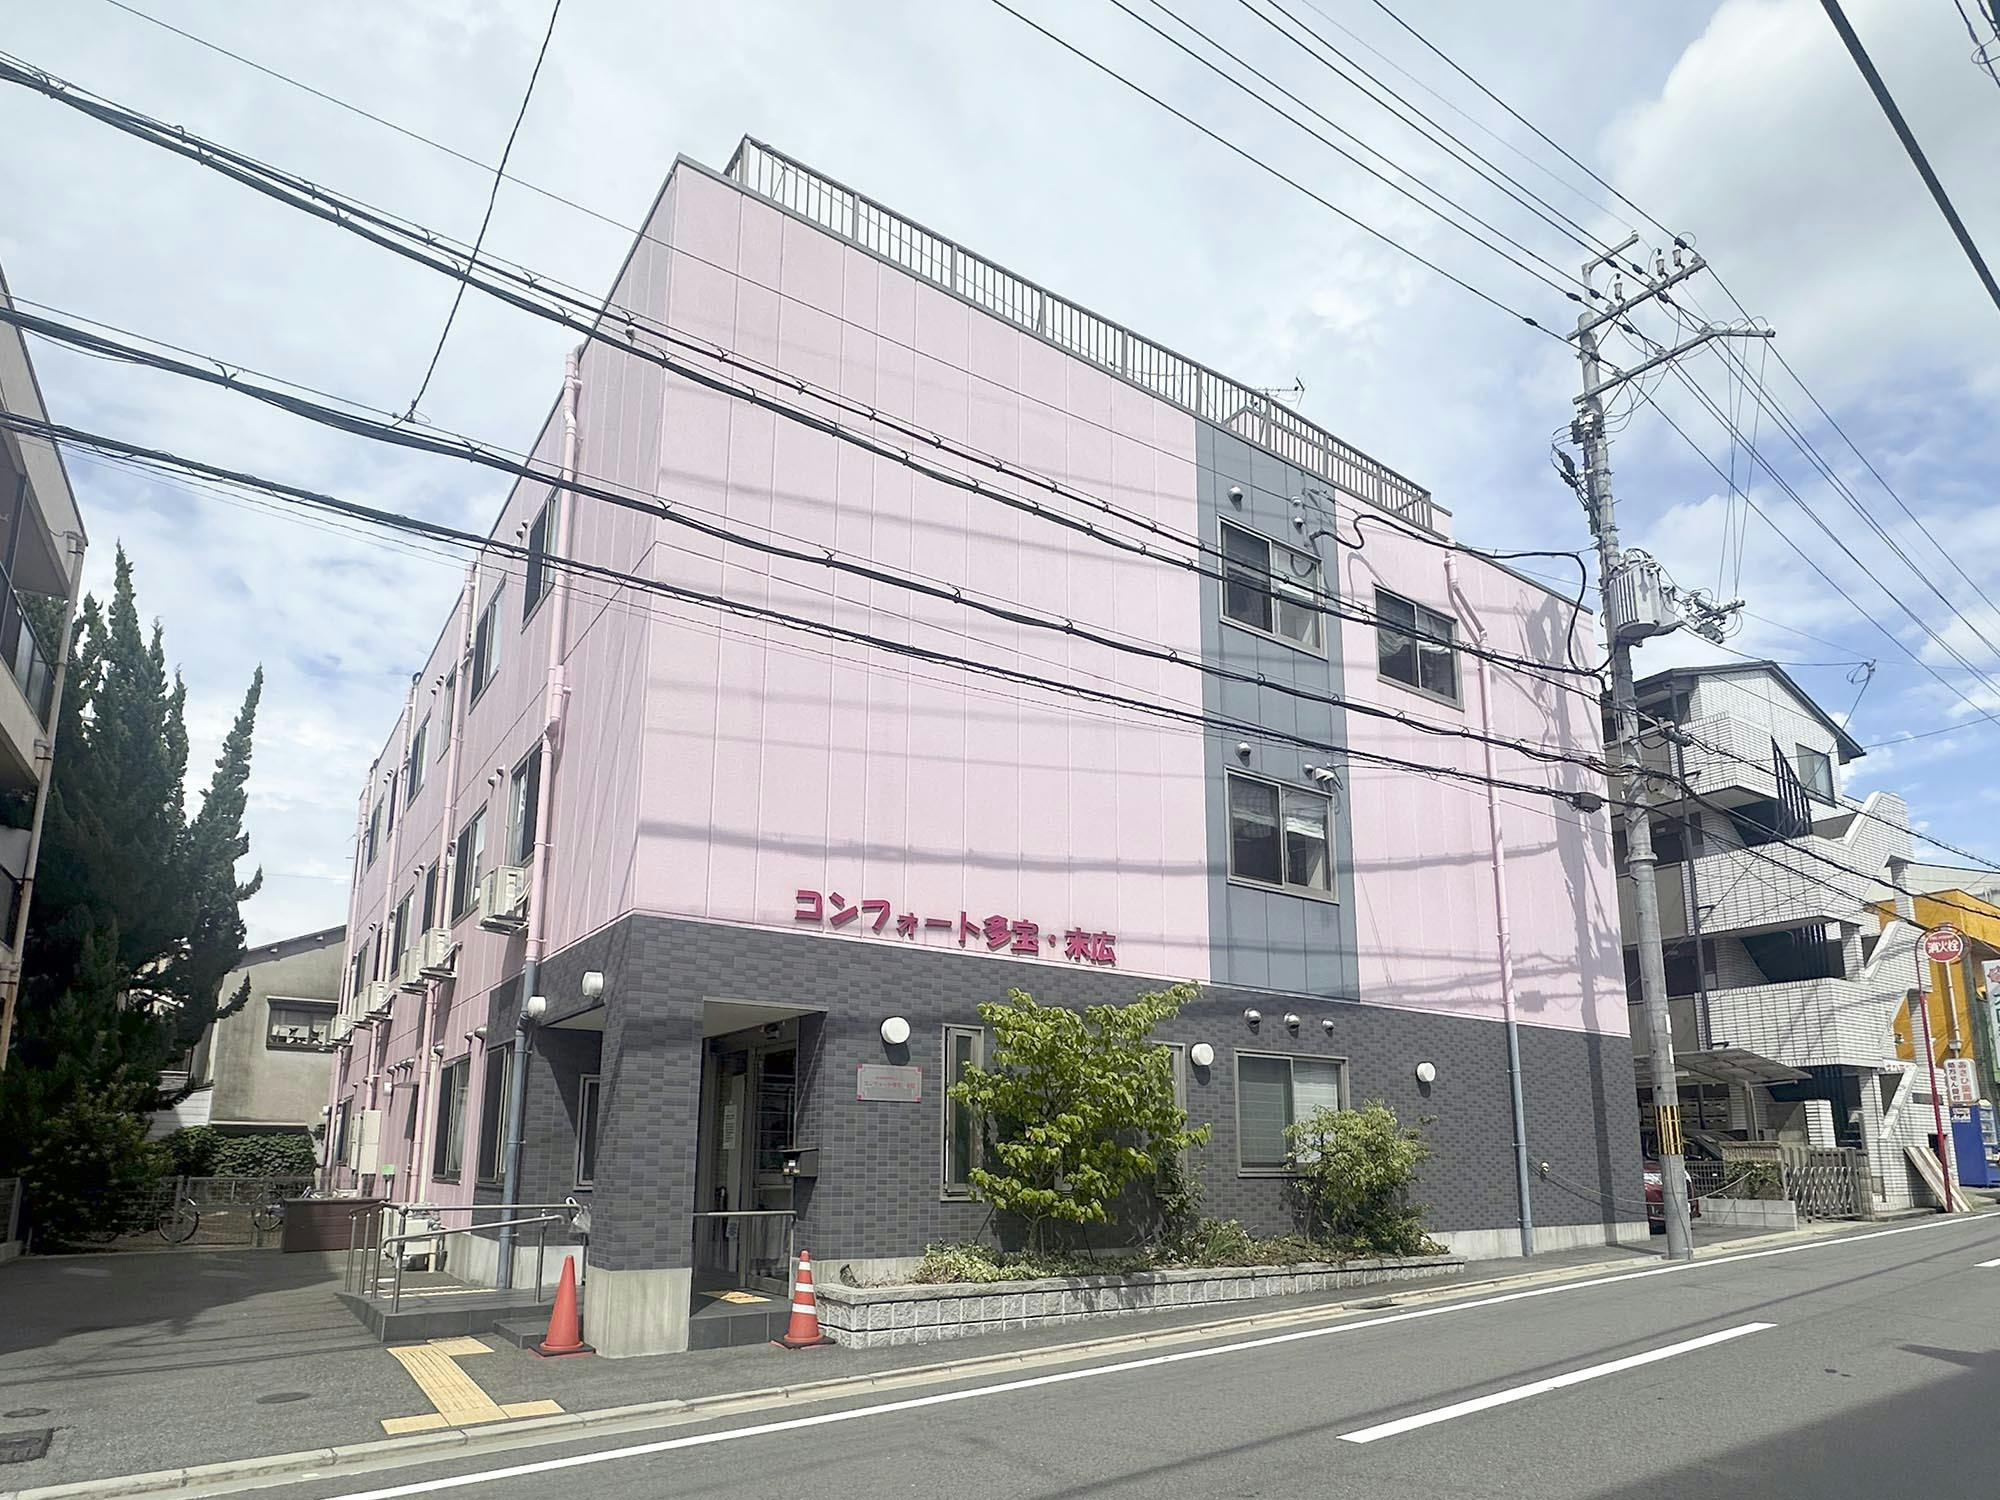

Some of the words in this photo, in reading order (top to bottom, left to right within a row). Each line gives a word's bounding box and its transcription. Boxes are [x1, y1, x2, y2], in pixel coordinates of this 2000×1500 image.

[795, 889, 1116, 966] コンフォート多宝・末広
[1928, 939, 1959, 954] 消火栓
